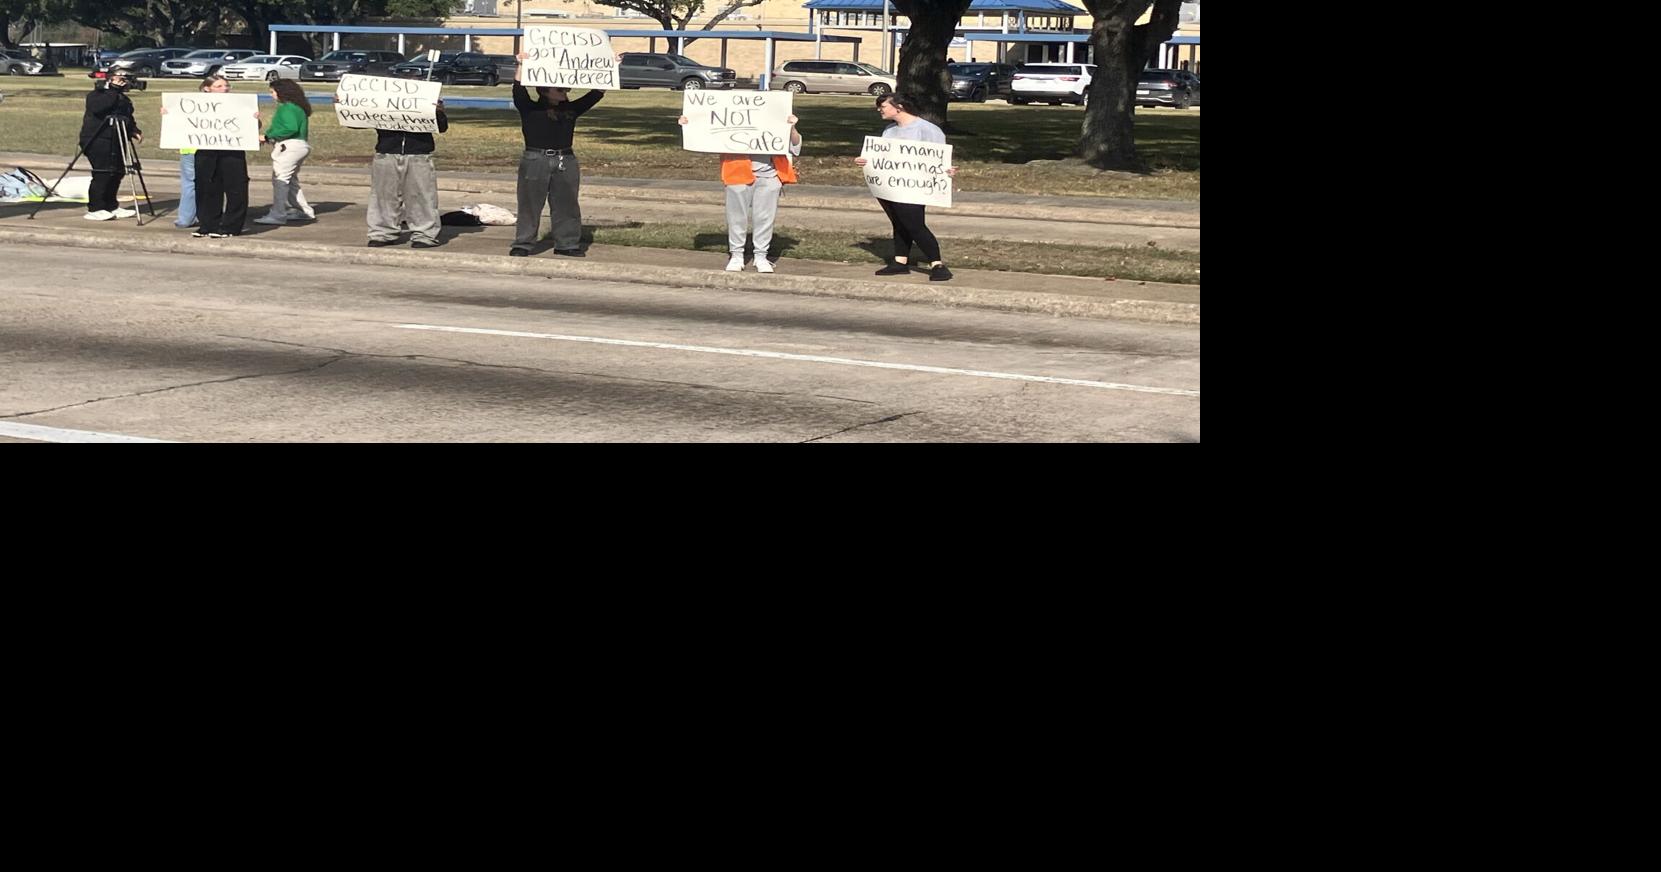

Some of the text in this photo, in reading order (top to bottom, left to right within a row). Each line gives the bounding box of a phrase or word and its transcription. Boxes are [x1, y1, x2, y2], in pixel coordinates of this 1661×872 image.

[530, 28, 602, 46] GCCISD
[559, 48, 614, 70] Andrew
[341, 76, 419, 94] GCCISD
[180, 98, 222, 114] Our
[340, 93, 428, 110] does NOT
[687, 92, 766, 106] We are
[340, 109, 400, 121] Protect
[711, 107, 760, 126] NOT
[725, 131, 785, 151] Safe
[865, 139, 944, 161] How many
[866, 174, 948, 195] are enough?
